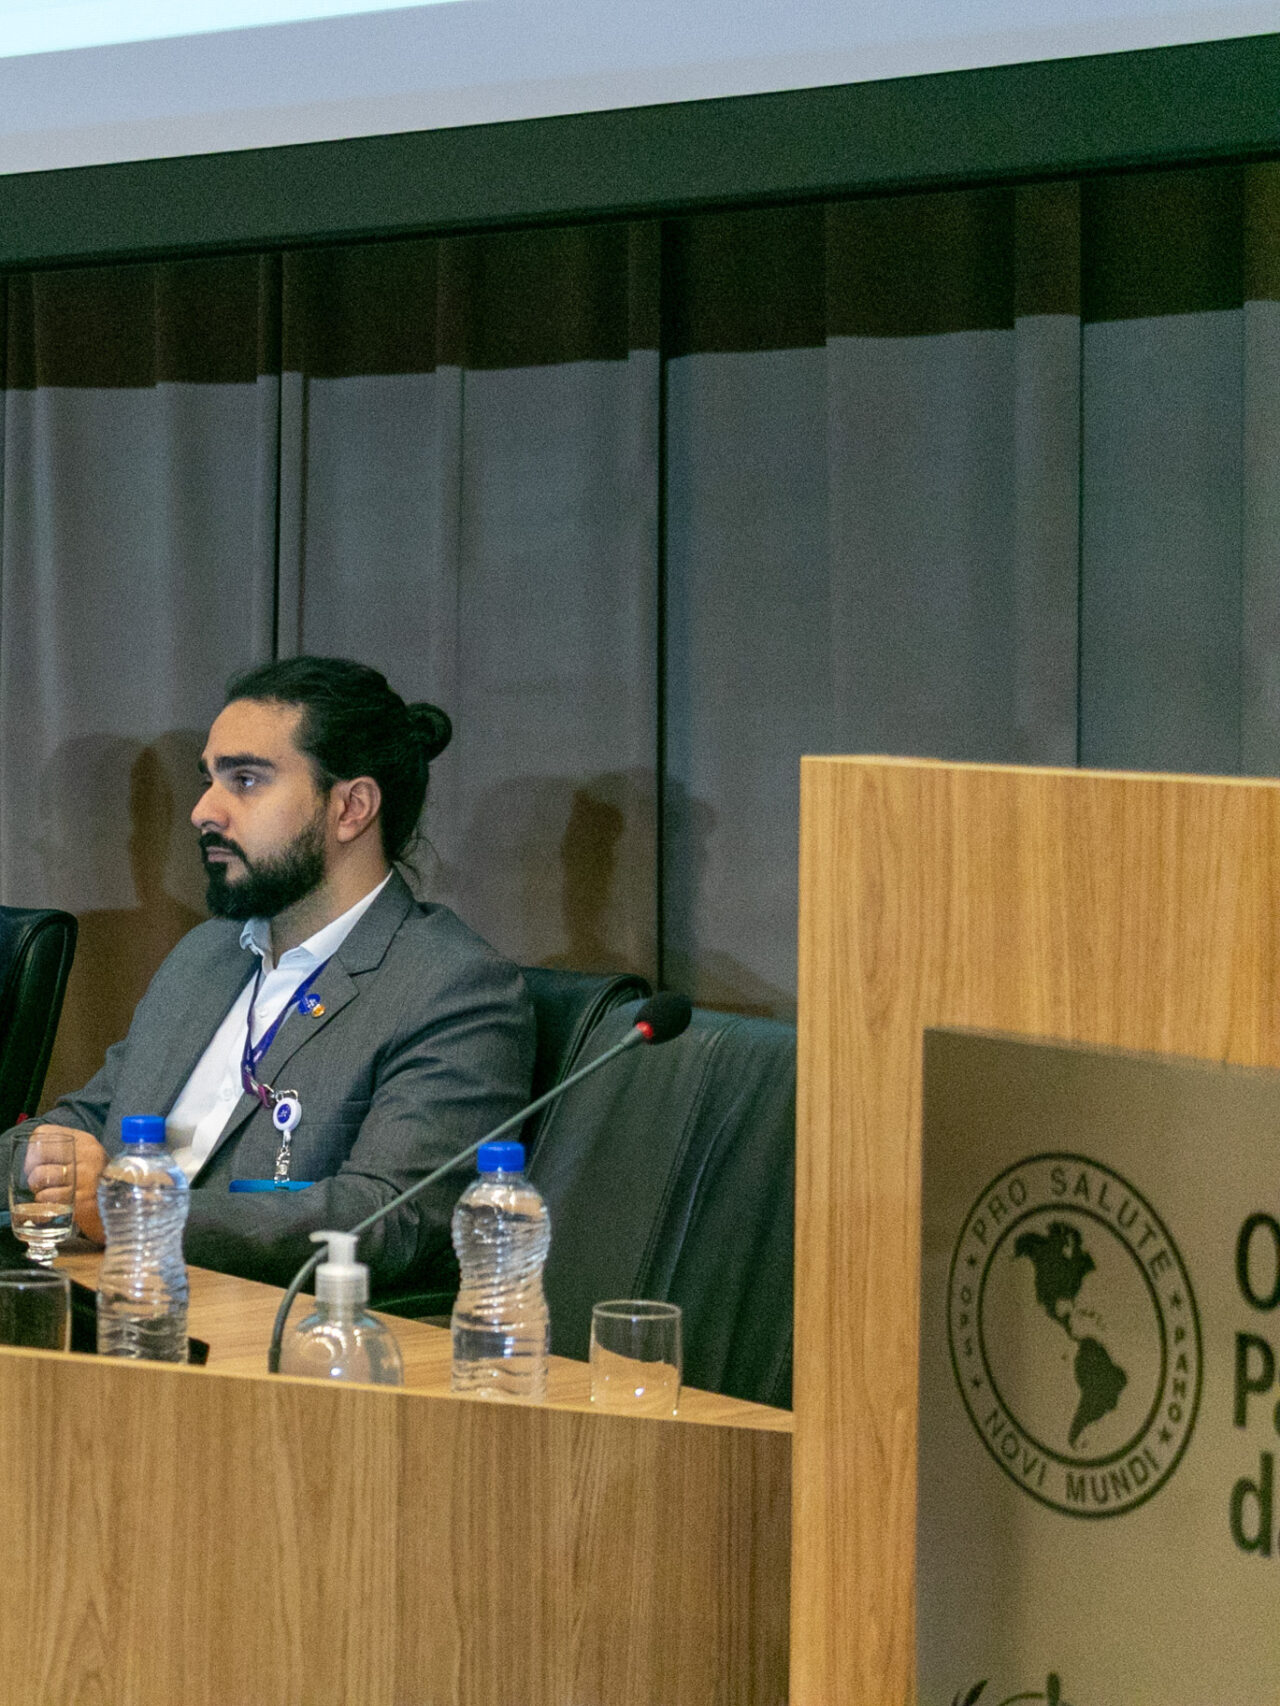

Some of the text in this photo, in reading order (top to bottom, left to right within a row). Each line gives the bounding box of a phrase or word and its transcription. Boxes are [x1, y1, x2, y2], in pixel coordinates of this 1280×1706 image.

[972, 1167, 1171, 1280] PRO SALUTE
[1233, 1331, 1280, 1430] P
[984, 1408, 1161, 1505] NOVI MUNDI
[1229, 1451, 1280, 1558] d
